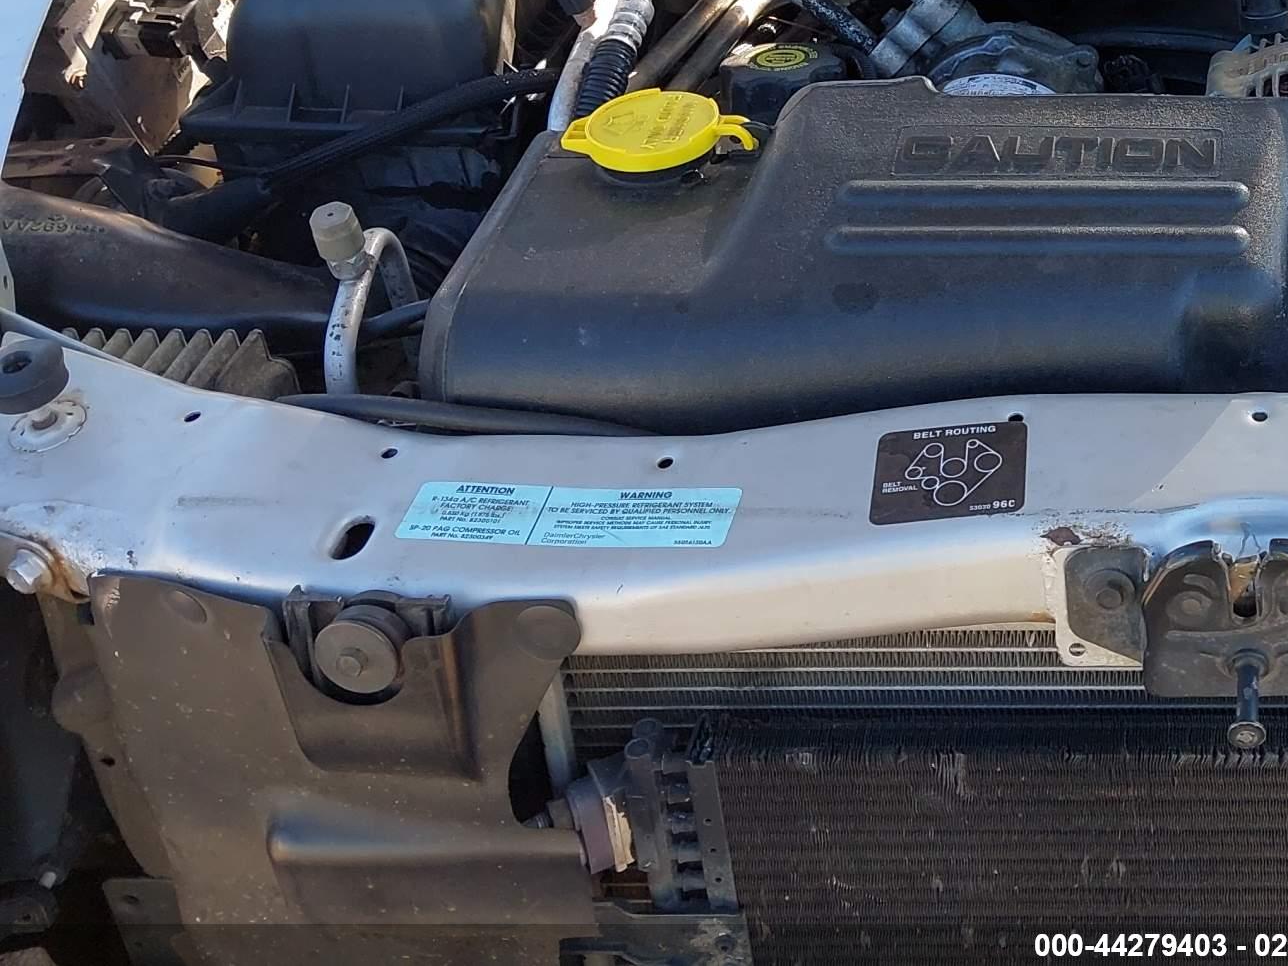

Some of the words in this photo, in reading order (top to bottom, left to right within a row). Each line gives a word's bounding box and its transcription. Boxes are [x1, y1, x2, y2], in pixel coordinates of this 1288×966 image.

[900, 135, 1217, 175] CAUTION
[913, 430, 942, 440] BELT
[945, 425, 996, 436] ROUTING
[456, 484, 516, 495] ATTENTION
[882, 484, 918, 493] REMOVAL
[620, 491, 673, 499] WARNING
[478, 497, 529, 506] REFRIGERANT
[452, 526, 507, 535] COMPRESSOR
[541, 537, 587, 545] Corporation
